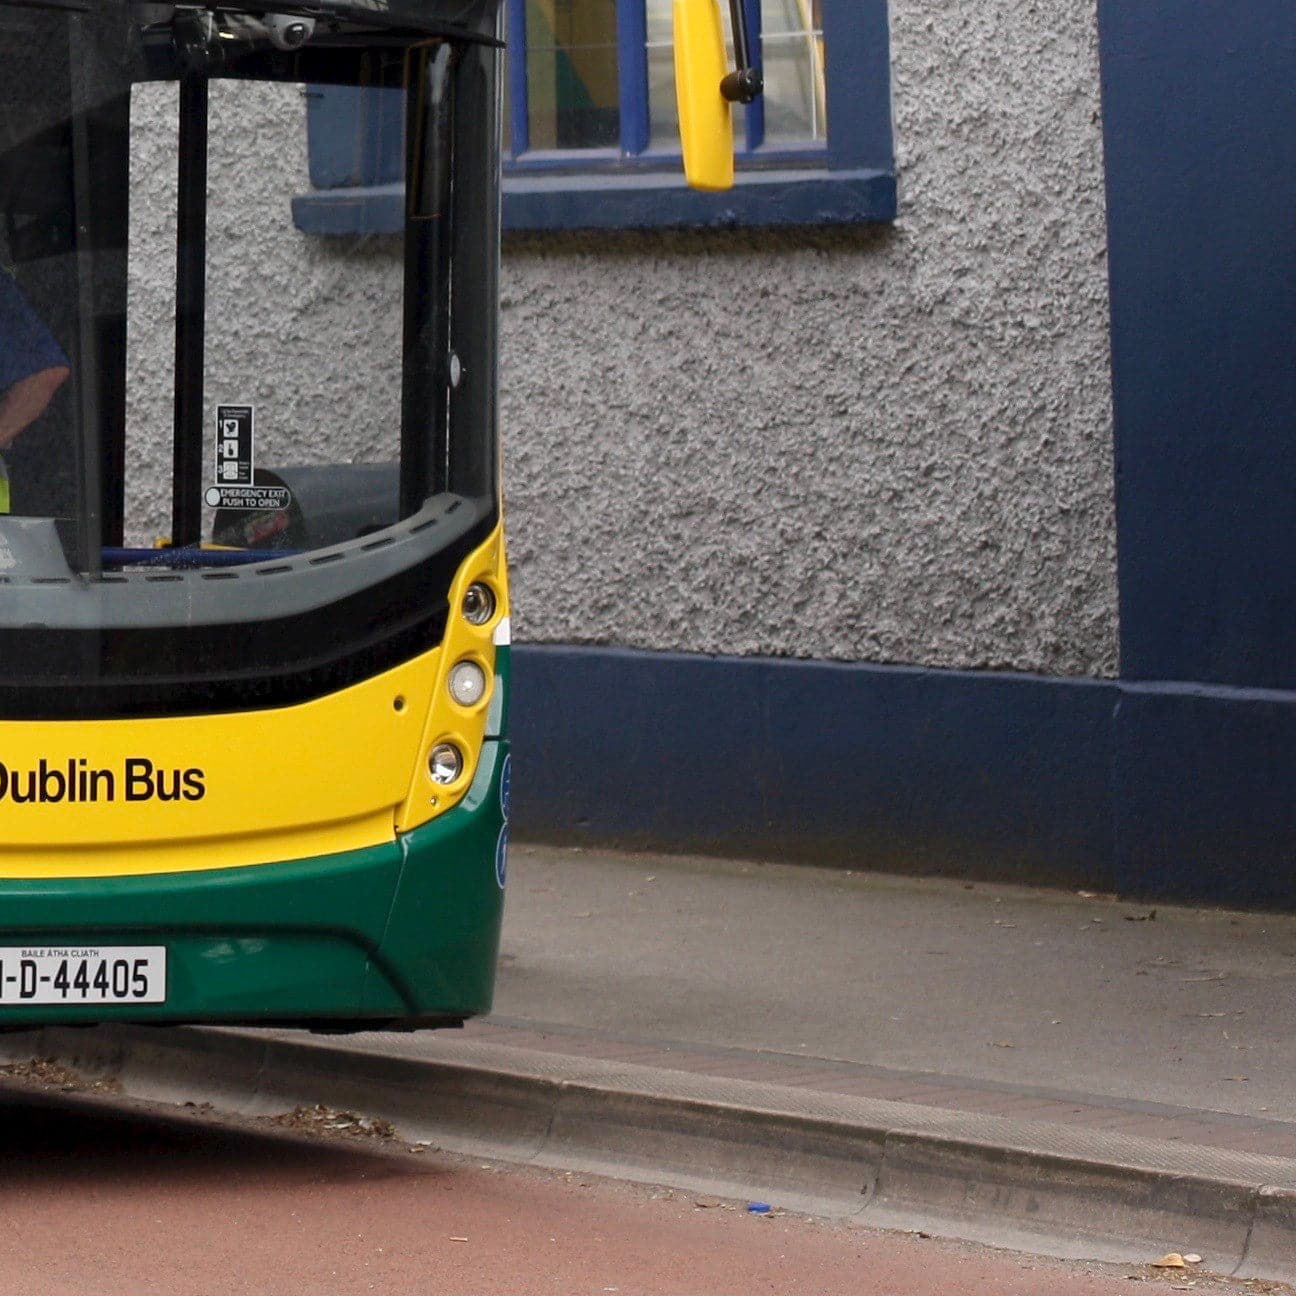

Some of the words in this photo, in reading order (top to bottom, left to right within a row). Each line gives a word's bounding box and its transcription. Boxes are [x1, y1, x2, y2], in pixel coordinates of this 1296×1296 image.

[221, 489, 267, 498] EMERGENCY
[269, 490, 285, 498] EXIT
[223, 498, 244, 507] PUSH
[246, 499, 256, 507] TO
[258, 499, 280, 507] OPEN
[125, 758, 206, 802] Bus
